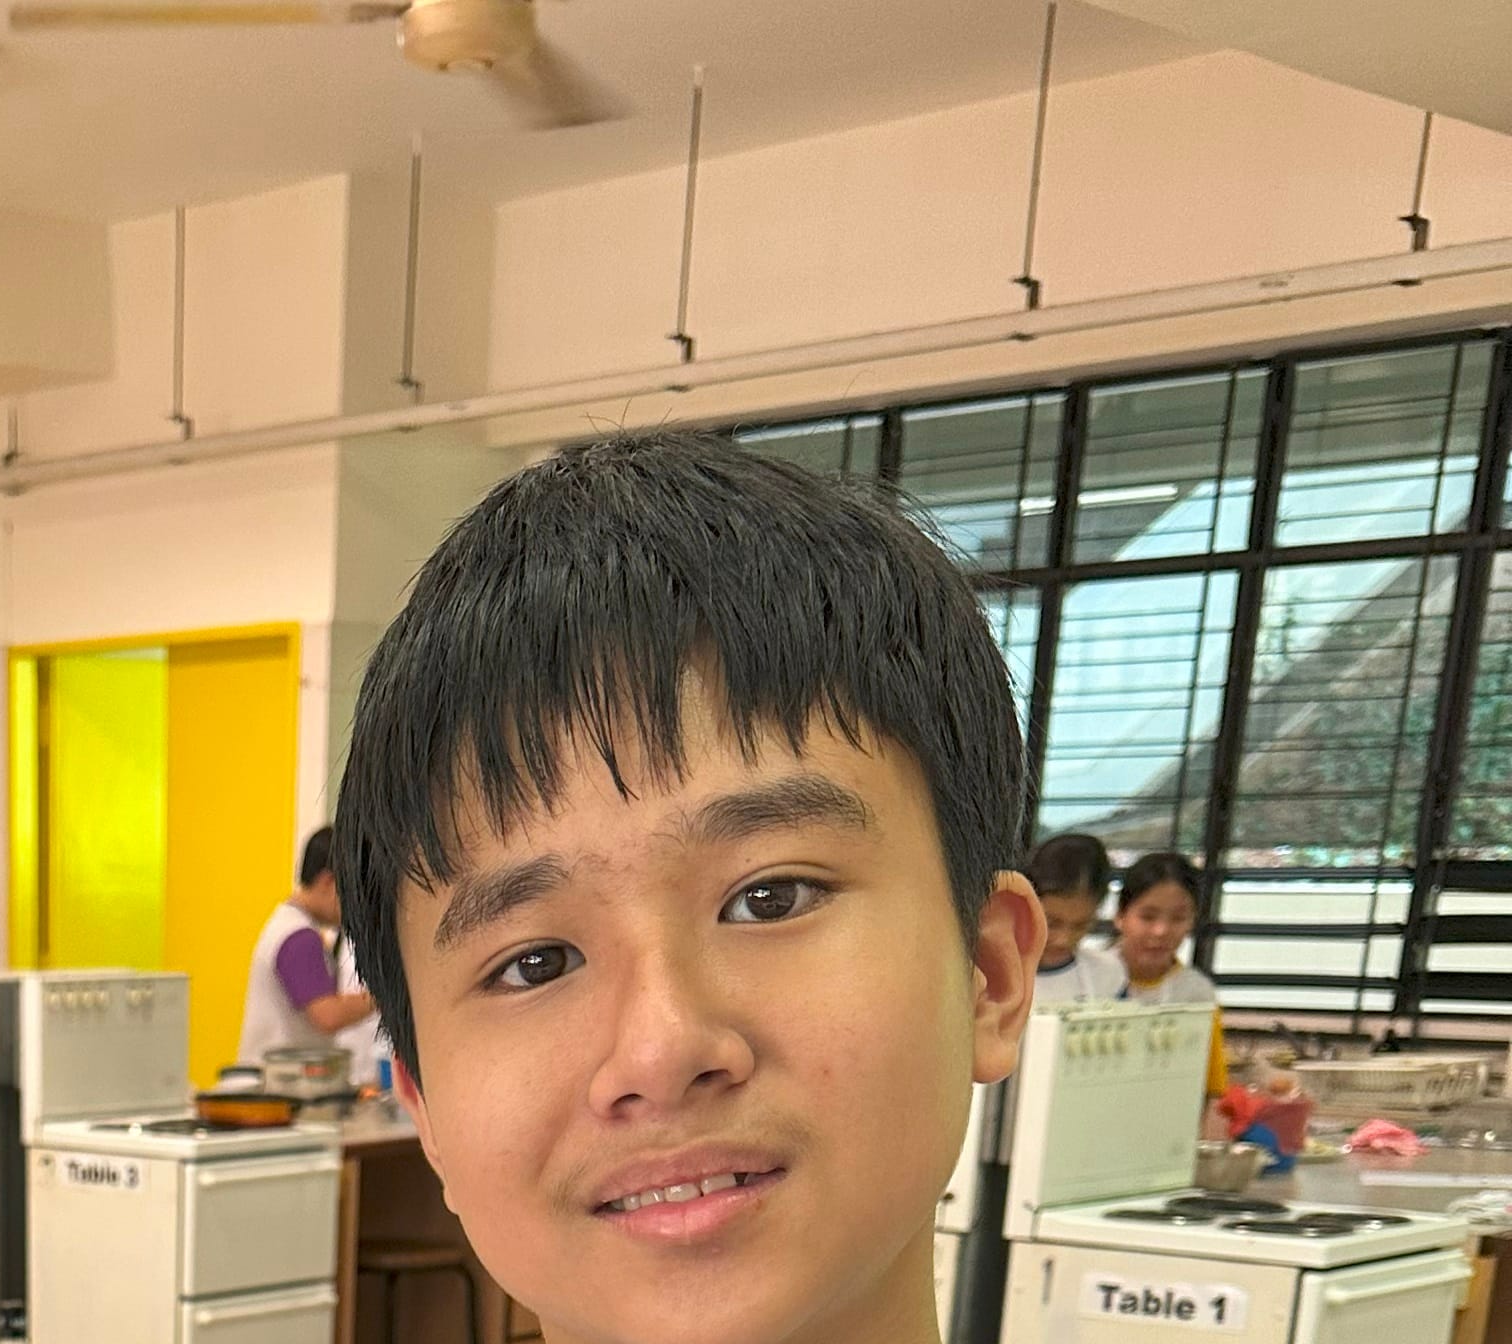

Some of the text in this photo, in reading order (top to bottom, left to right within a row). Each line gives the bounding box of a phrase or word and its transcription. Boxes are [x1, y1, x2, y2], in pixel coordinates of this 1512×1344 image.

[67, 1161, 120, 1187] Table
[1097, 1281, 1227, 1324] Table 1
